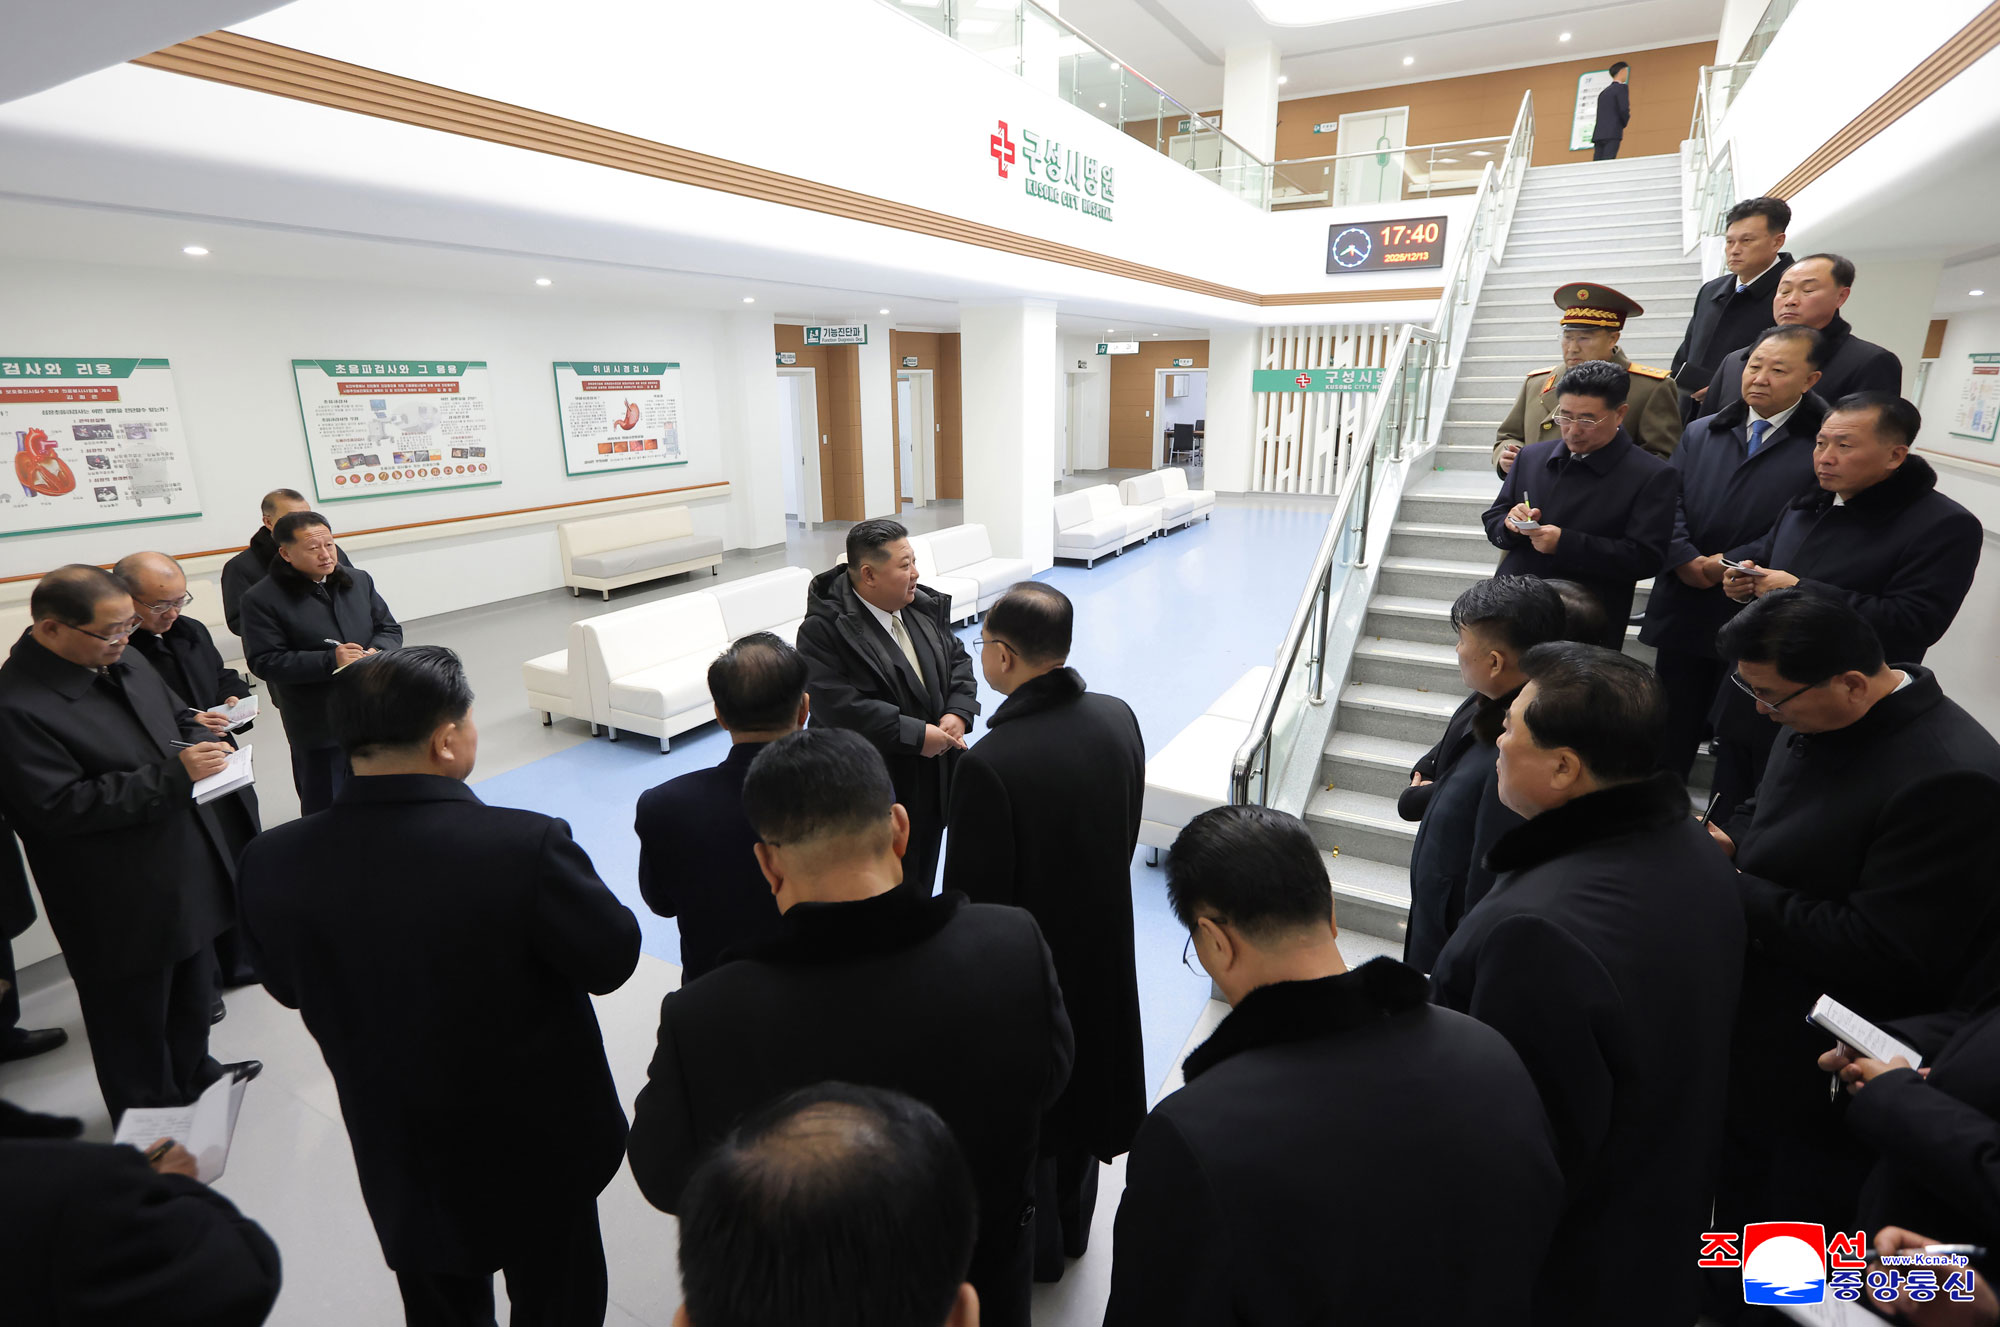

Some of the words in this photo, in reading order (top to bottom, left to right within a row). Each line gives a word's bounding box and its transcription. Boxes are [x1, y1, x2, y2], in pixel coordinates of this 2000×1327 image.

[1022, 128, 1115, 203] 구성시병원
[1025, 178, 1060, 204] KUSONG
[1061, 191, 1079, 210] CITY
[1081, 198, 1113, 222] HOSPITAL
[1380, 223, 1439, 246] 17:40
[1383, 251, 1430, 263] 2025/12/13
[823, 326, 861, 337] 기능진단과
[2, 362, 62, 376] 검사와
[75, 363, 112, 376] 리용
[335, 364, 410, 375] 초음파검사와
[417, 364, 429, 374] 그
[436, 364, 457, 374] 응용
